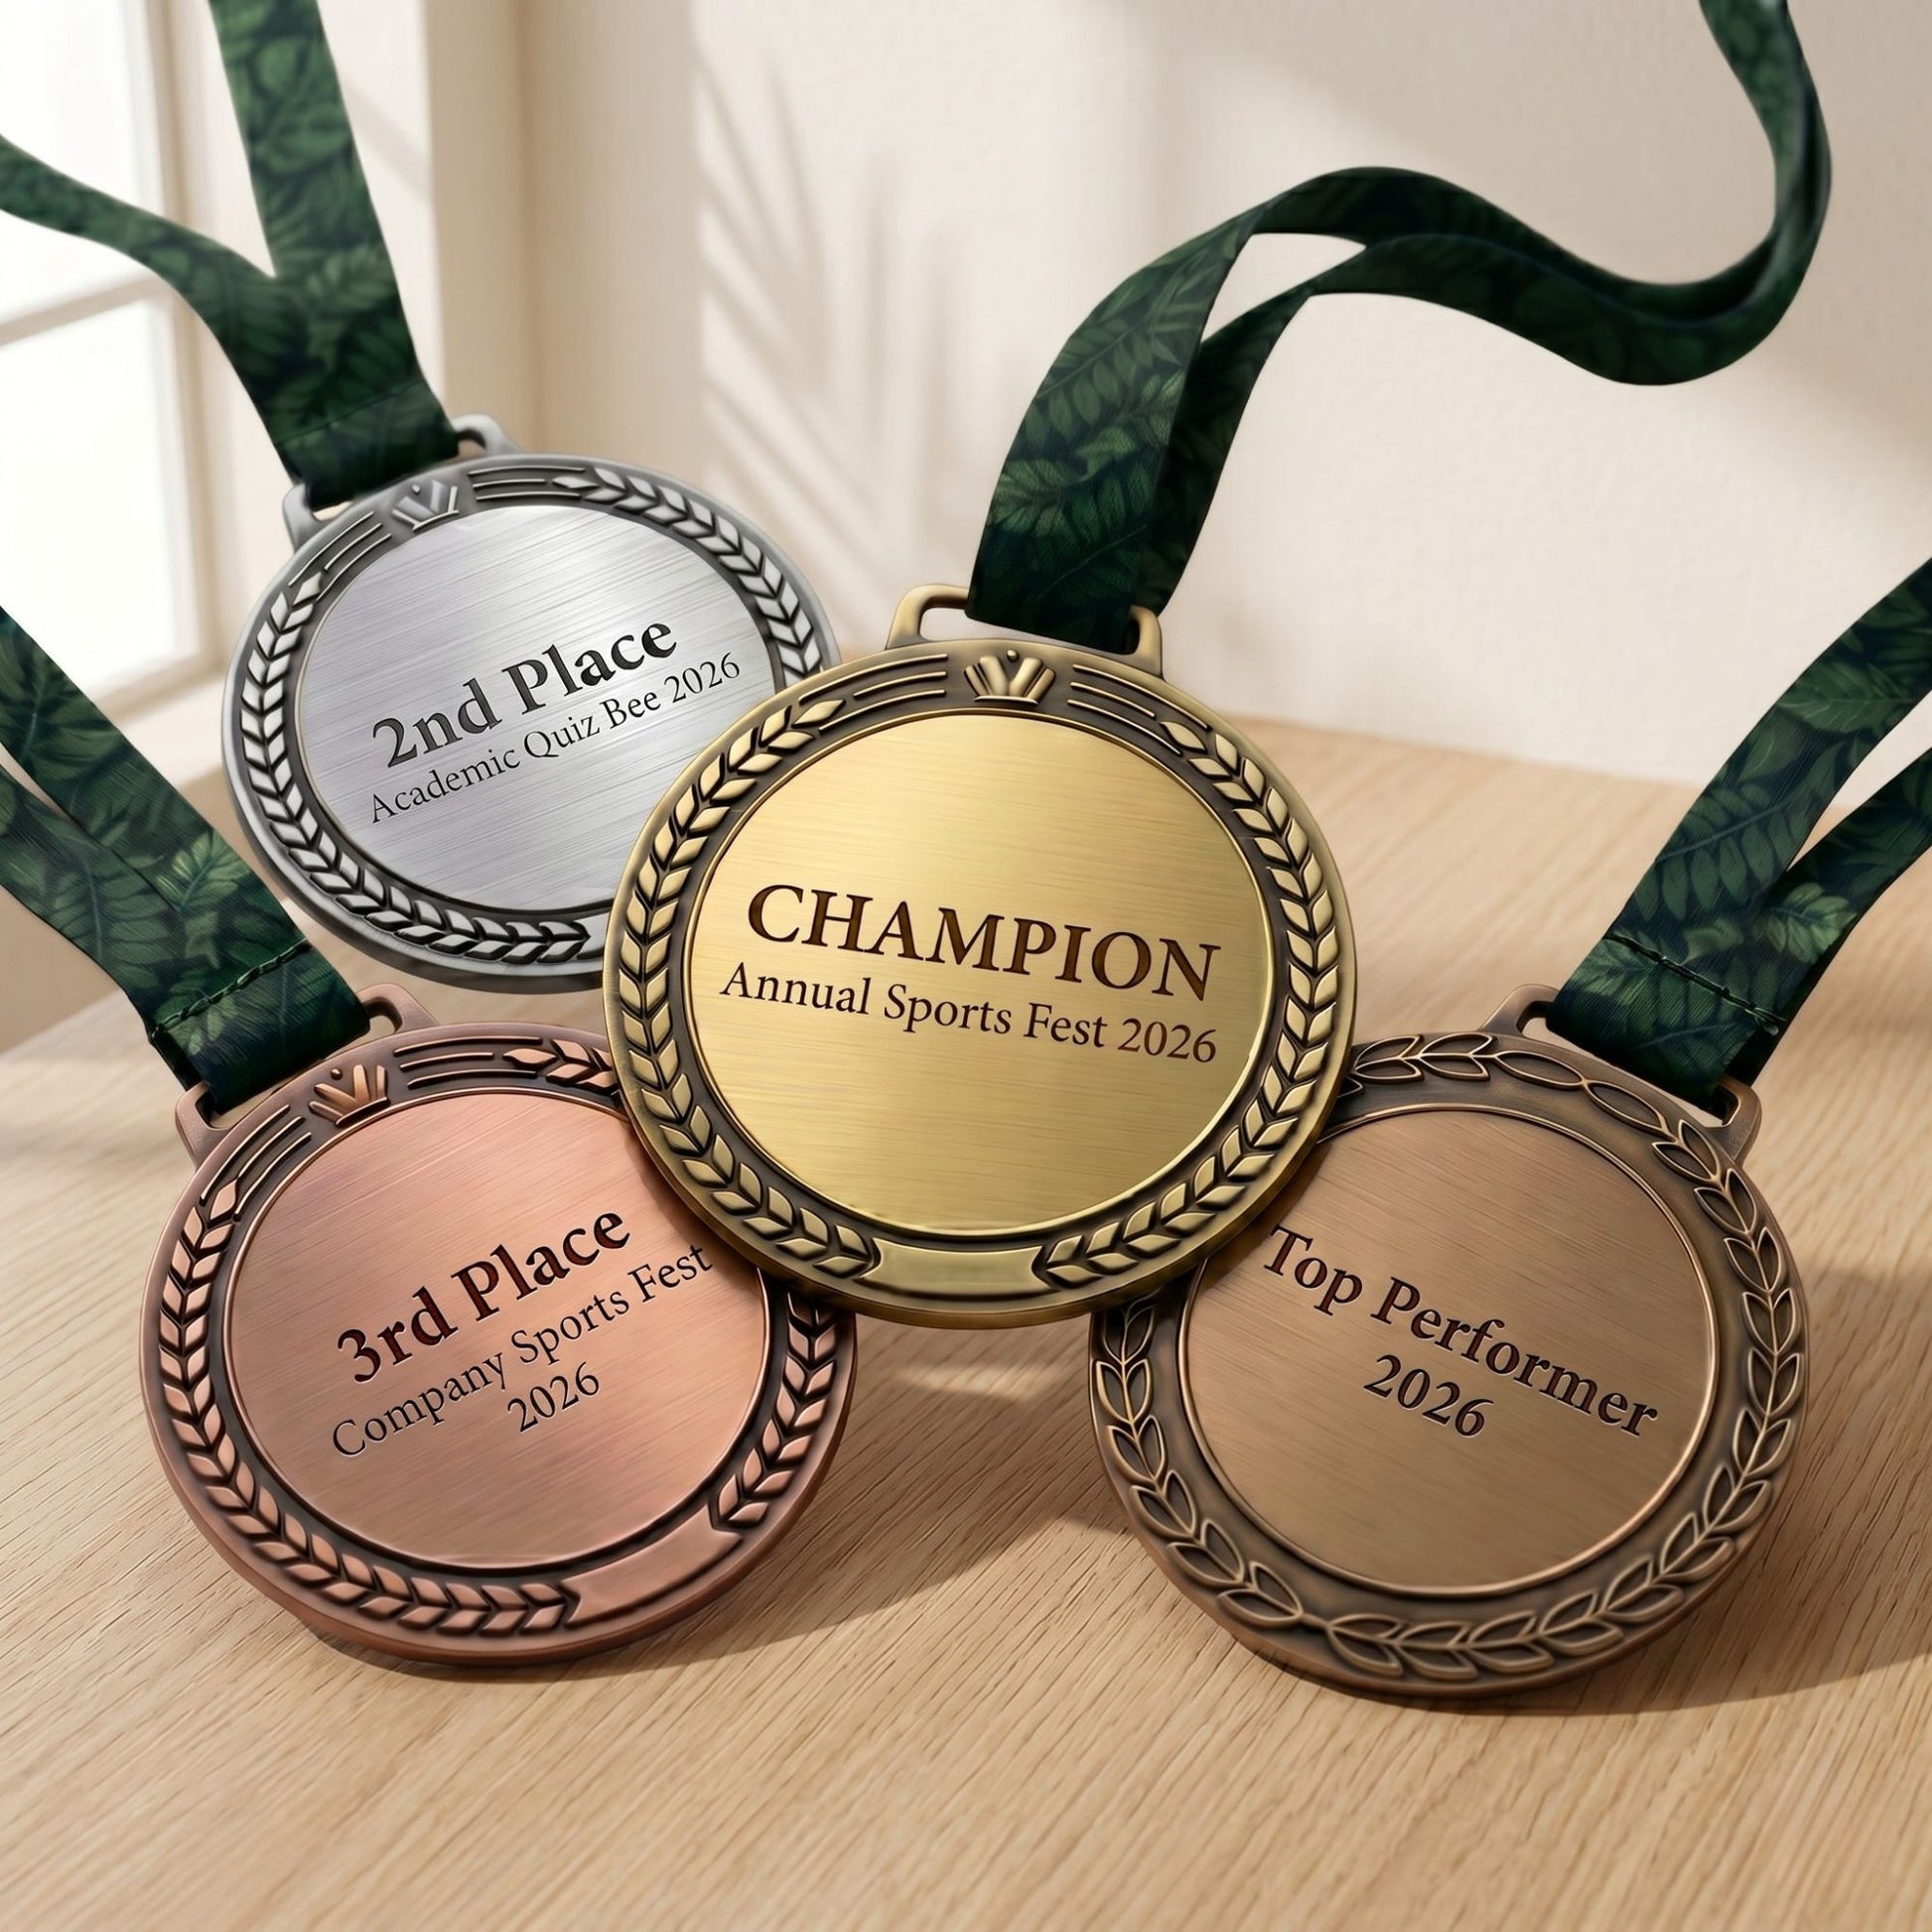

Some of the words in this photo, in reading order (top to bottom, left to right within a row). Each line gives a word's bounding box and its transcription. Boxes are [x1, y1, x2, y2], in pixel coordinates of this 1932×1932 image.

[371, 749, 521, 823] Academic
[523, 714, 601, 759] Quiz
[600, 690, 661, 731] Bee
[664, 651, 741, 703] 2026
[372, 677, 502, 768] 2nd
[501, 622, 677, 715] Place
[720, 961, 872, 1015] Annual
[884, 983, 1012, 1034] Sports
[1024, 1002, 1108, 1048] Fest
[1117, 1018, 1217, 1063] 2026
[748, 884, 1222, 1002] CHAMPION
[333, 1352, 506, 1456] Company
[510, 1291, 630, 1365] Sports
[627, 1244, 714, 1303] Fest
[338, 1286, 458, 1383] 3rd
[451, 1211, 630, 1321] Place
[1263, 1224, 1363, 1316] Top
[1370, 1276, 1658, 1438] Performer
[507, 1361, 601, 1433] 2026
[1363, 1354, 1493, 1438] 2026
